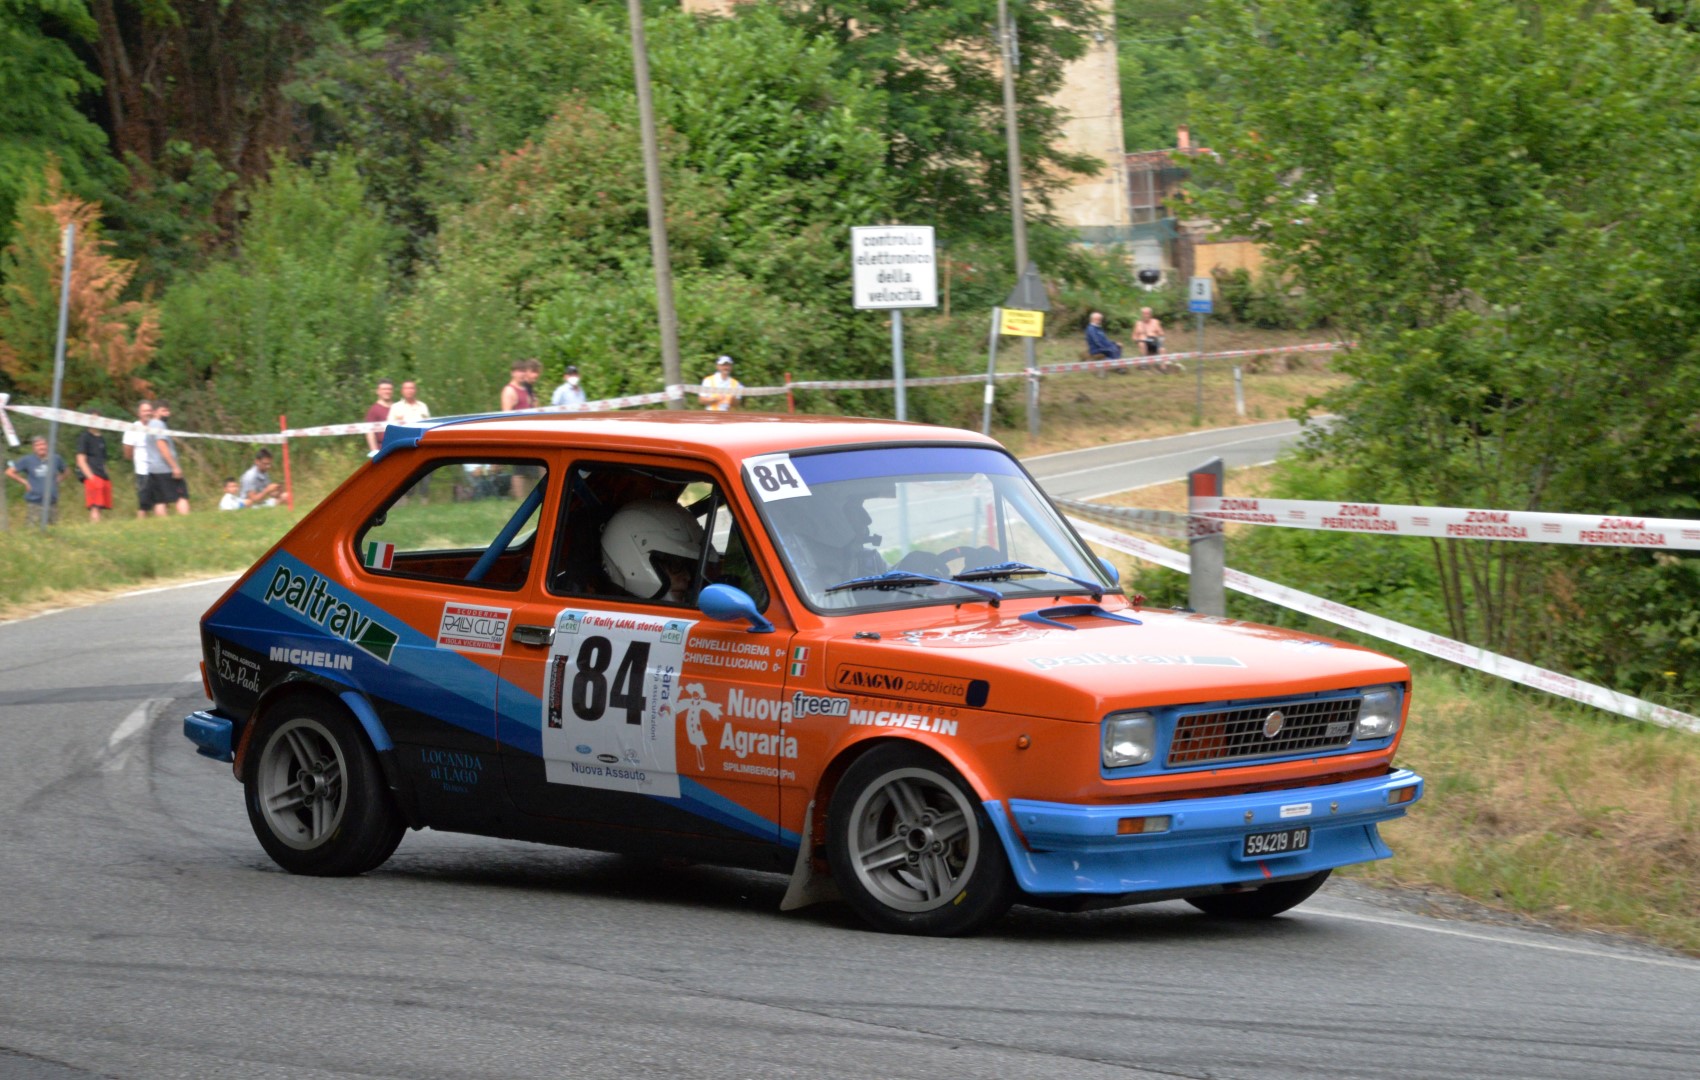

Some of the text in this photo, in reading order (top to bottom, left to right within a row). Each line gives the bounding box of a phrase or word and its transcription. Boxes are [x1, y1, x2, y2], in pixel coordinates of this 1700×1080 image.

[862, 233, 924, 247] controllo
[856, 250, 932, 265] elettronico
[877, 269, 912, 283] della
[753, 463, 799, 492] 84
[1219, 499, 1260, 511] ZONA
[1338, 504, 1381, 517] ZONA
[1321, 517, 1398, 531] PERICOLOSA
[1464, 511, 1510, 523] ZONA
[1597, 518, 1646, 530] ZONA
[1446, 524, 1529, 539] PERICOLOSA
[1579, 530, 1667, 545] PERICOLOSA
[264, 564, 370, 645] paltrav
[456, 608, 499, 618] SCUDERIA
[442, 615, 506, 637] RALLY CLUB
[594, 616, 614, 630] Rally
[615, 619, 636, 630] LANA
[636, 622, 664, 633] storico
[463, 640, 496, 649] VICENTINA
[688, 637, 730, 652] CHIVELLI
[731, 642, 770, 657] LORENA
[270, 646, 353, 670] MICHELIN
[684, 652, 724, 666] CHIVELLI
[725, 657, 768, 672] LUCIANO
[237, 667, 260, 692] Paoli
[572, 636, 652, 726] 84
[660, 665, 675, 701] sara
[839, 669, 904, 691] ZAVAGNO
[650, 684, 660, 741] assicurazioni
[727, 688, 793, 723] Nuova
[794, 692, 849, 716] freem
[853, 695, 959, 717] SPILIMBERGO
[849, 709, 959, 736] MICHELIN
[719, 722, 798, 759] Agraria
[421, 749, 482, 770] LOCANDA
[723, 762, 779, 777] SPILIMBERGO
[443, 767, 478, 785] LAGO
[571, 762, 646, 781] Nuova Assauto
[1247, 829, 1308, 854] 594219 PD
